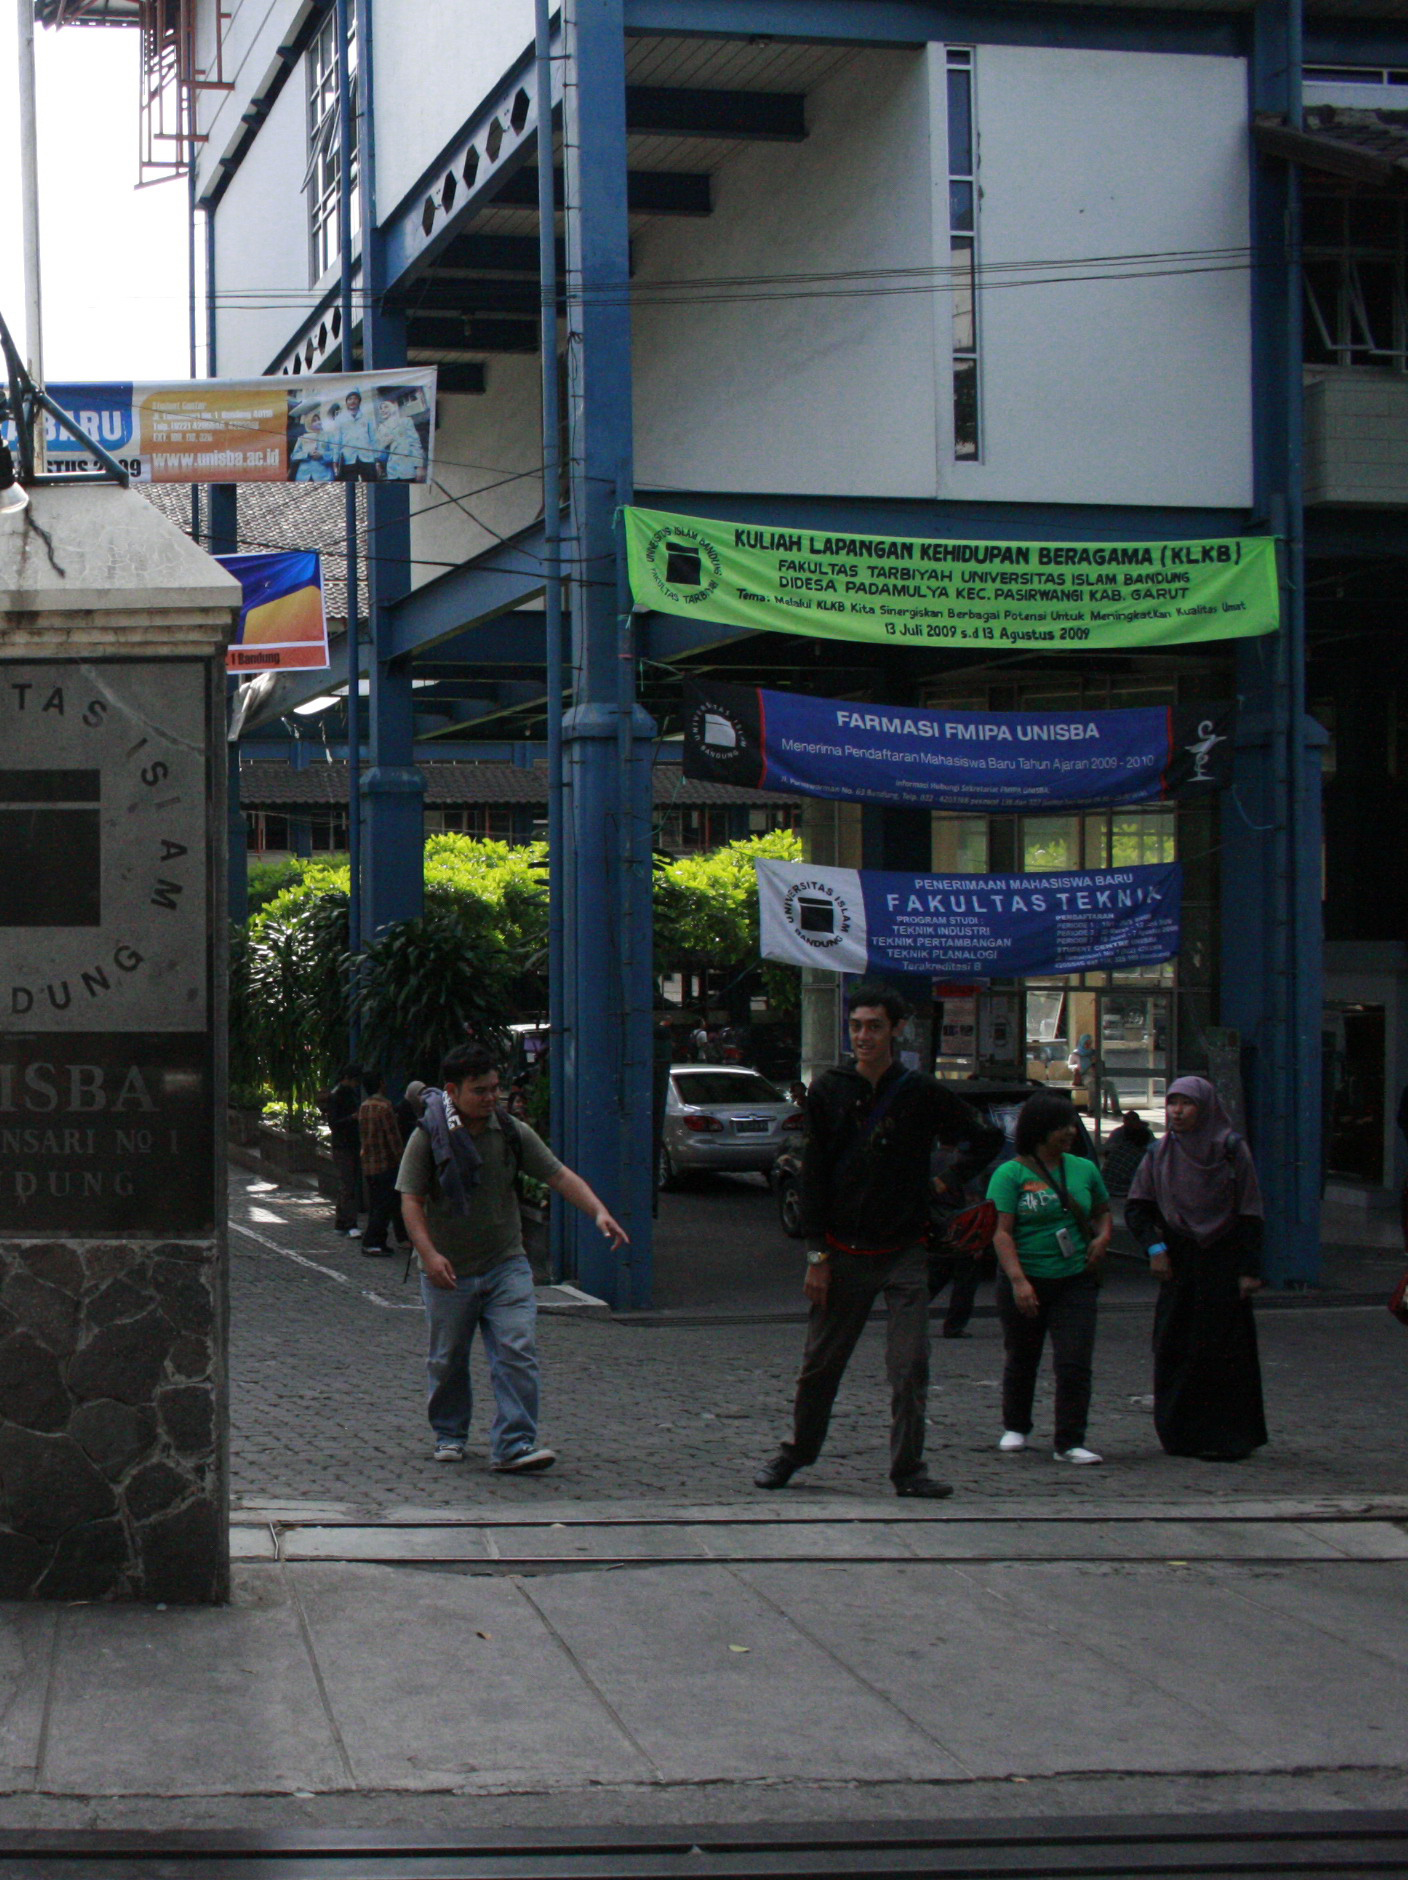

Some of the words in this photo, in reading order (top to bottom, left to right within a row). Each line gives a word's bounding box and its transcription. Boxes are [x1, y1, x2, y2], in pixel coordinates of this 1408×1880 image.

[42, 410, 122, 441] BARU
[153, 448, 280, 467] www.unisba.ac.id
[674, 526, 698, 541] ISLAM
[734, 529, 801, 551] KULIAH
[810, 536, 914, 560] LAPANGAN
[920, 543, 1029, 565] KEHIDUPAN
[1038, 546, 1153, 566] BERAGAMA
[1160, 541, 1242, 568] (KLKB)
[778, 559, 859, 577] FAKULTAS
[867, 565, 953, 582] TARBIYAH
[961, 570, 1067, 586] UNIVERSITAS
[1071, 573, 1117, 586] ISLAM
[1124, 571, 1190, 586] BANDUNG
[779, 575, 837, 593] DIDESA
[845, 581, 949, 599] PADAMULYA
[956, 587, 991, 600] KEC.
[994, 588, 1084, 602] PASIRWANGI
[1089, 589, 1127, 602] KAB.
[1131, 587, 1190, 600] GARUT
[774, 595, 812, 609] Melalui
[816, 600, 846, 613] KLKB
[850, 602, 876, 615] Kita
[879, 604, 943, 620] Sinergiskan
[947, 607, 1000, 623] Berbagai
[1004, 610, 1047, 621] Potensi
[1050, 610, 1085, 621] Untuk
[1176, 604, 1218, 617] Kualitas
[1221, 600, 1247, 612] Umat
[884, 622, 896, 635] 13
[899, 623, 923, 637] Juli
[926, 624, 957, 638] 2009
[960, 626, 979, 639] s.d
[982, 627, 994, 640] 13
[999, 627, 1055, 644] Agustus
[1059, 626, 1090, 641] 2009
[238, 652, 281, 665] Bandung
[836, 711, 939, 737] FARMASI
[945, 722, 1013, 741] FMIPA
[1016, 722, 1100, 742] UNISBA
[781, 738, 843, 757] Menerima
[845, 745, 920, 763] Pendaftaran
[921, 751, 986, 769] Mahasiswa
[988, 757, 1016, 770] Baru
[1017, 757, 1051, 770] Tahun
[1053, 758, 1089, 773] Ajaran
[1091, 756, 1117, 770] 2009
[1126, 754, 1154, 768] 2010
[895, 779, 929, 790] Informasi
[914, 878, 1007, 890] PENERIMAAN
[1009, 876, 1093, 890] MAHASISWA
[1095, 873, 1134, 886] BARU
[783, 881, 834, 923] UNIVERSITAS
[834, 896, 851, 933] ISLAM
[886, 893, 1047, 913] FAKULTAS
[1056, 885, 1162, 911] TEKNIK
[895, 915, 947, 924] PROGRAM
[948, 916, 979, 924] STUDI
[795, 928, 843, 948] BANDUNG
[892, 925, 935, 935] TEKNIK
[937, 926, 991, 936] INDUSTRI
[871, 936, 914, 946] TEKNIK
[916, 937, 1012, 948] PERTAMBANGAN
[886, 948, 930, 959] TEKNIK
[973, 962, 982, 971] B
